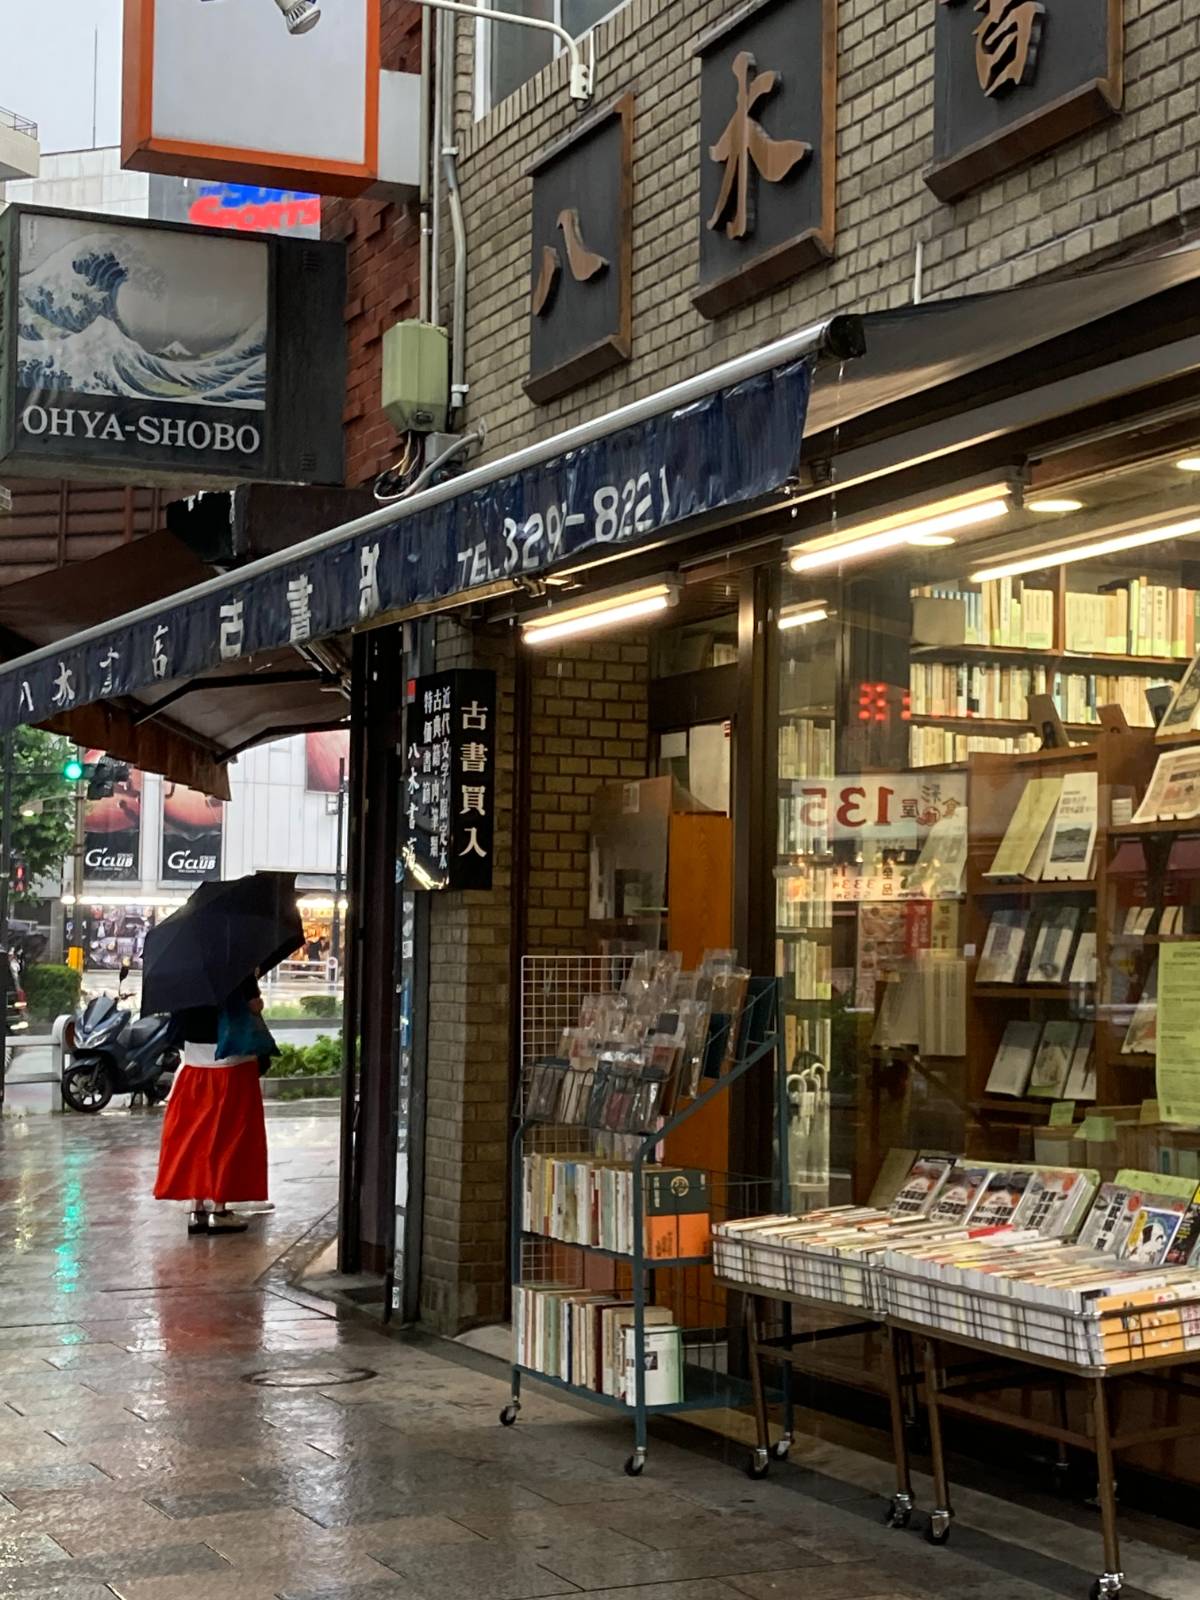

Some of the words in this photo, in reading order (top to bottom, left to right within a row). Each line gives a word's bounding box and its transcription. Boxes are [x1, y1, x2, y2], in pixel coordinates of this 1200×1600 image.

[706, 50, 813, 240] 木
[534, 208, 609, 316] 八
[22, 405, 261, 453] OHYA-SHOBO
[458, 700, 488, 858] 古書買入
